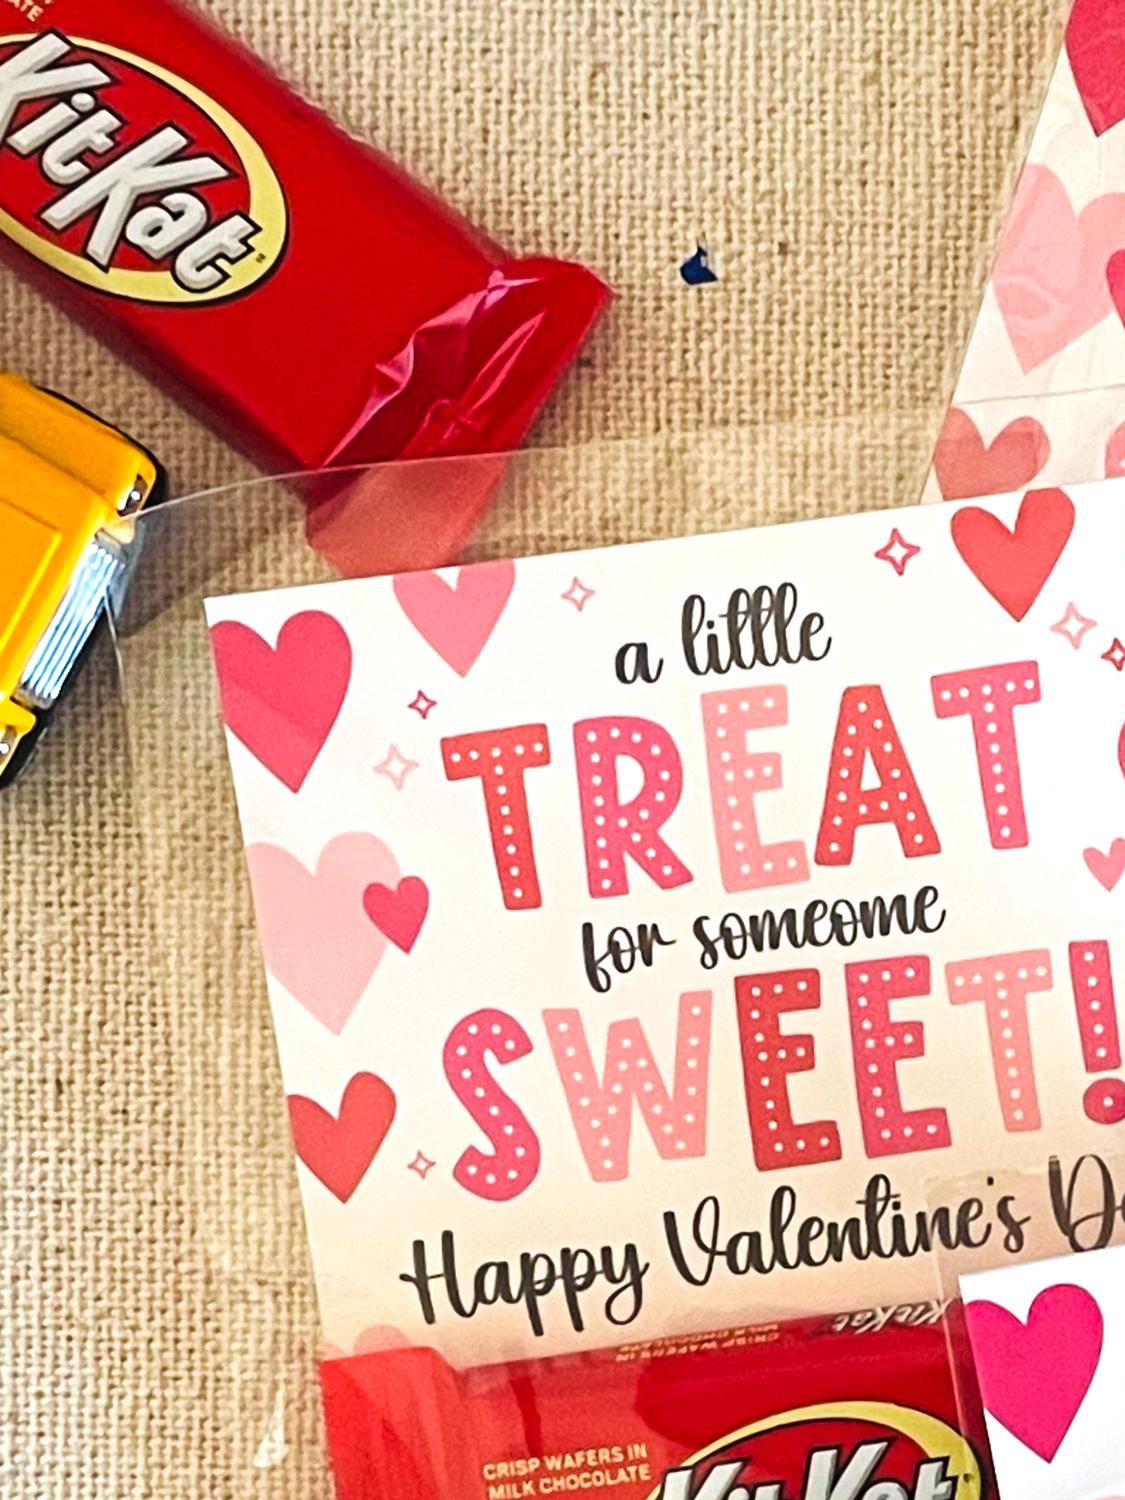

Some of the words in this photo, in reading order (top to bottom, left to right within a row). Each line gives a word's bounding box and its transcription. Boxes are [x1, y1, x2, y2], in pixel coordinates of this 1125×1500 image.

[614, 635, 664, 685] a
[681, 581, 833, 678] little
[439, 659, 1043, 911] TREAT
[582, 921, 677, 993] for
[399, 1228, 651, 1337] Happy
[663, 1173, 1032, 1287] Valentine's
[482, 1457, 541, 1481] CRISP
[544, 1446, 624, 1473] WAFERS
[627, 1443, 649, 1461] IN
[539, 1463, 652, 1497] CHOCOLATE
